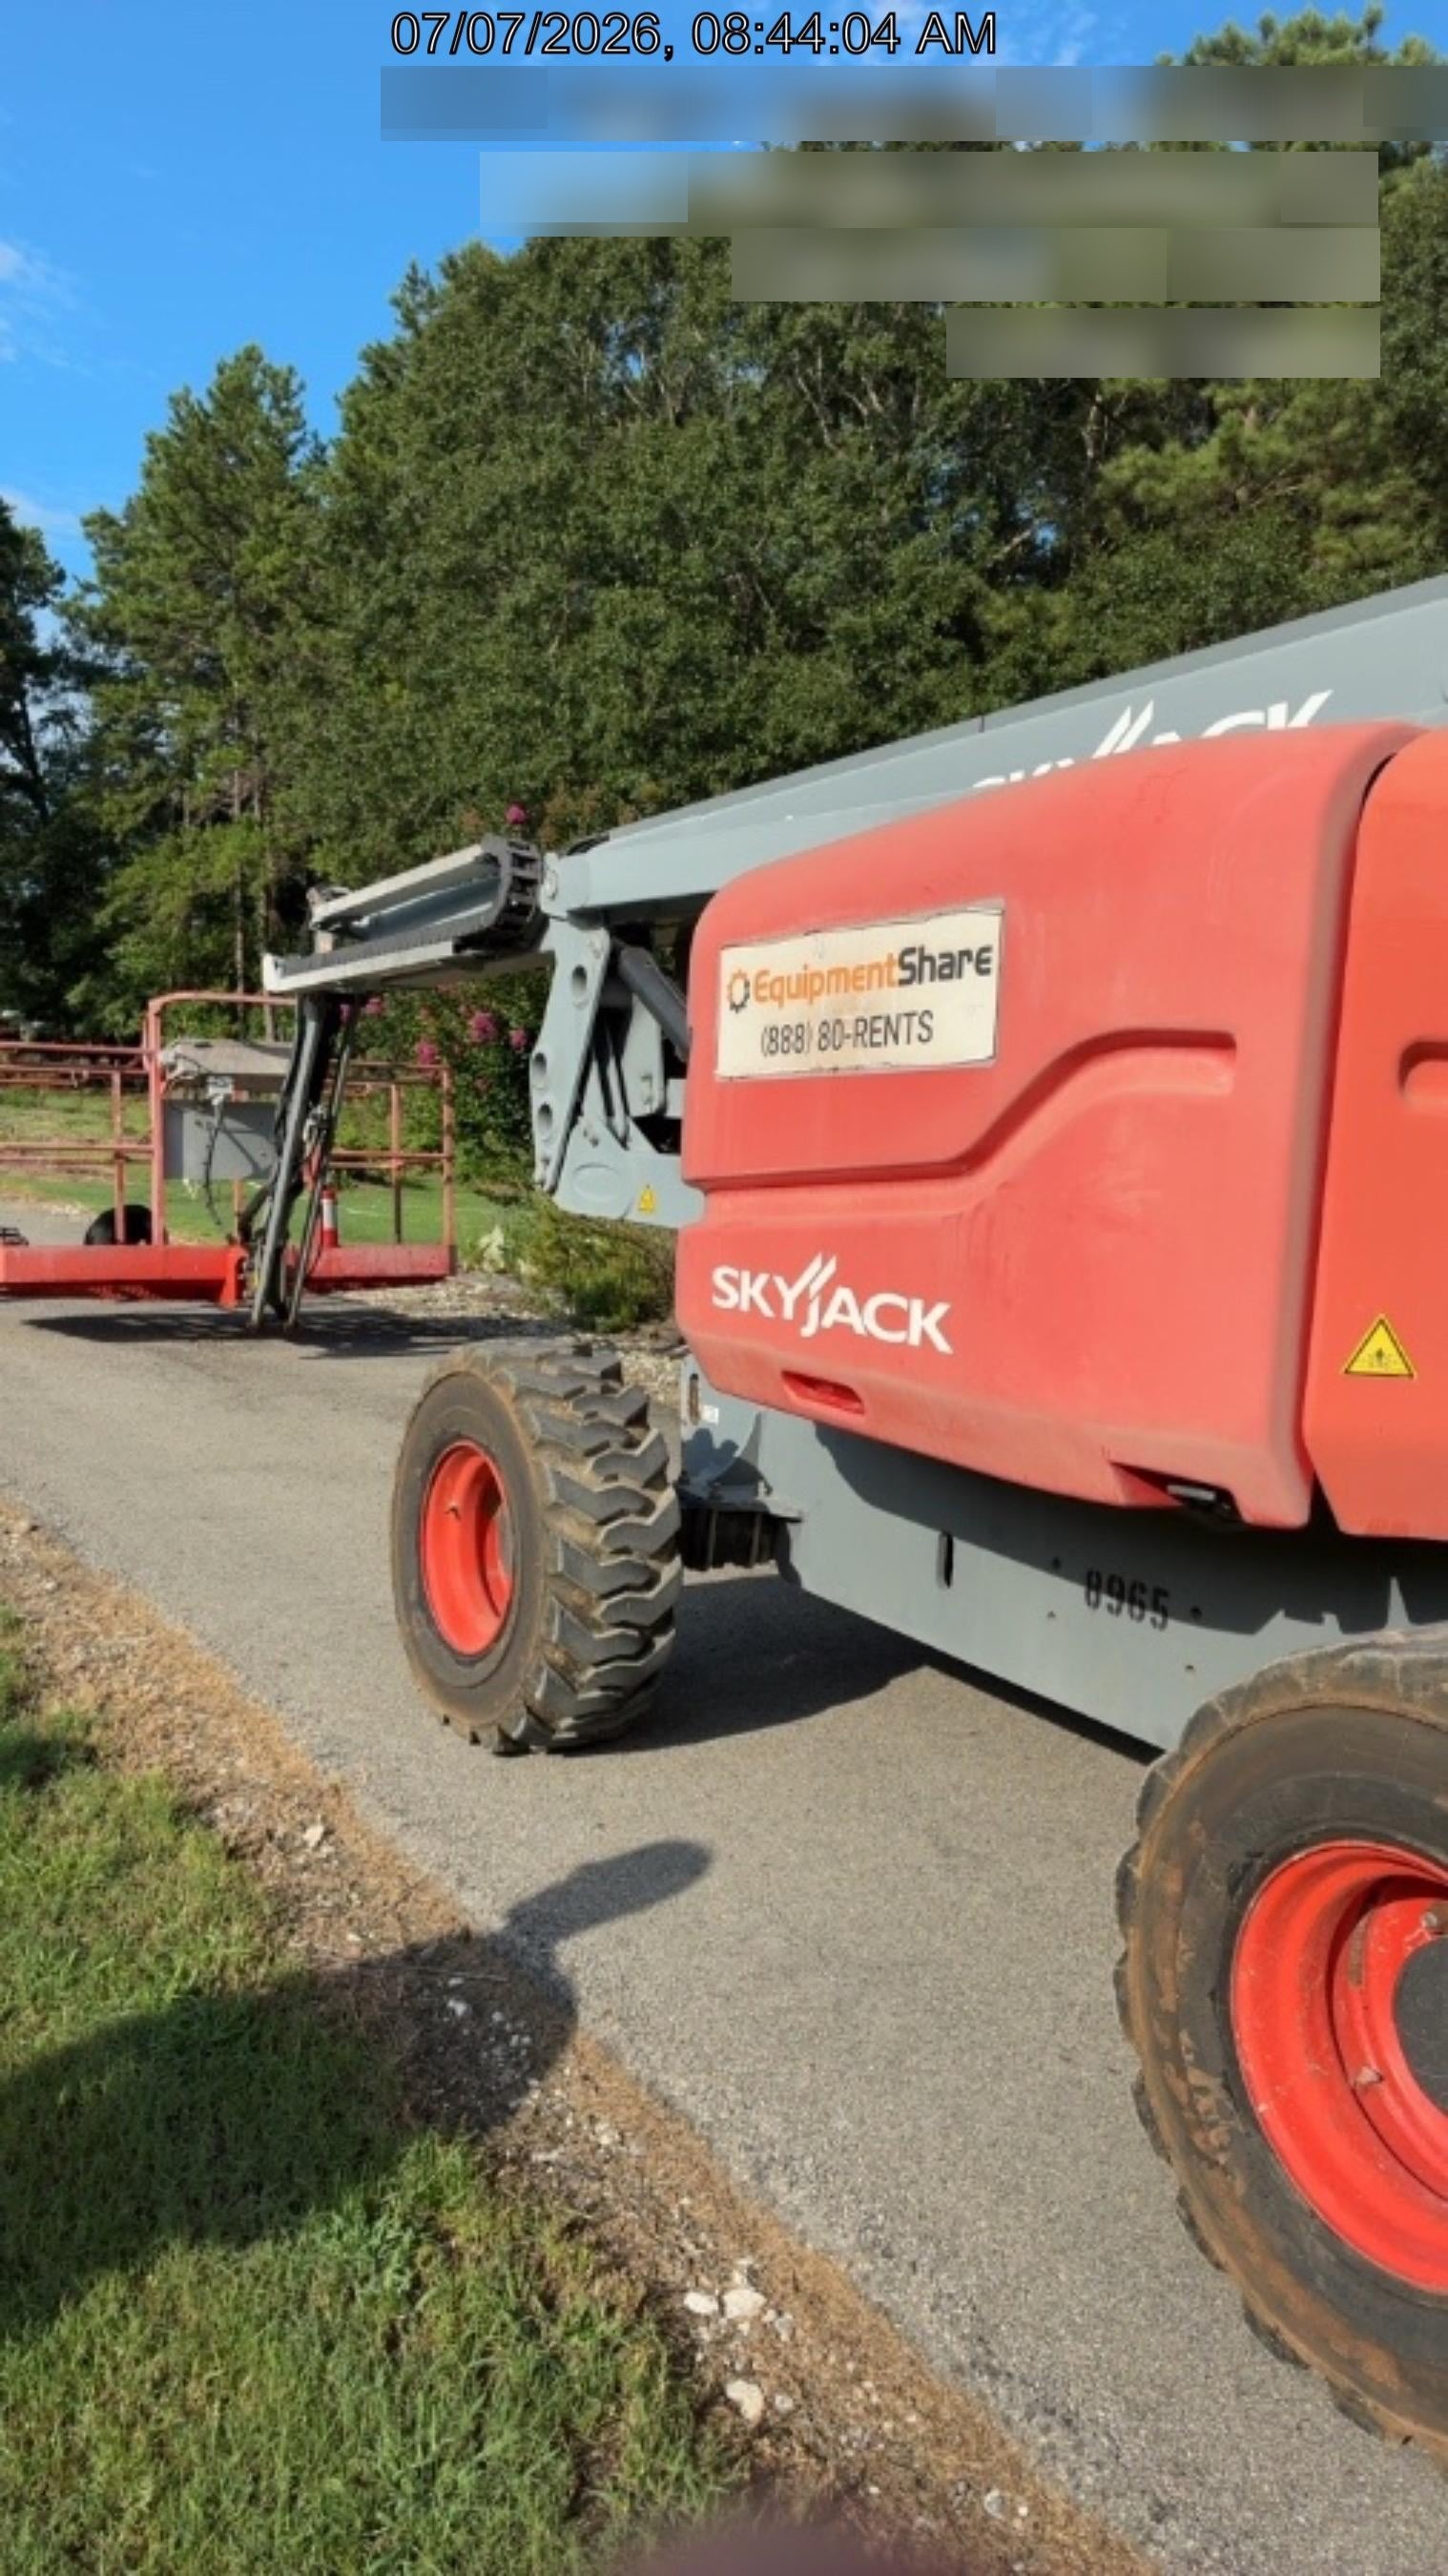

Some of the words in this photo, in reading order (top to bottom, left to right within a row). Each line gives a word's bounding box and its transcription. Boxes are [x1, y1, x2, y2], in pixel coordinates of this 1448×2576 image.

[753, 945, 993, 1008] EquipmentShare
[760, 1022, 811, 1056] (888)
[817, 1009, 934, 1051] 80-RENTS
[711, 1252, 953, 1355] SKYJACK
[1085, 1568, 1169, 1631] 8965
